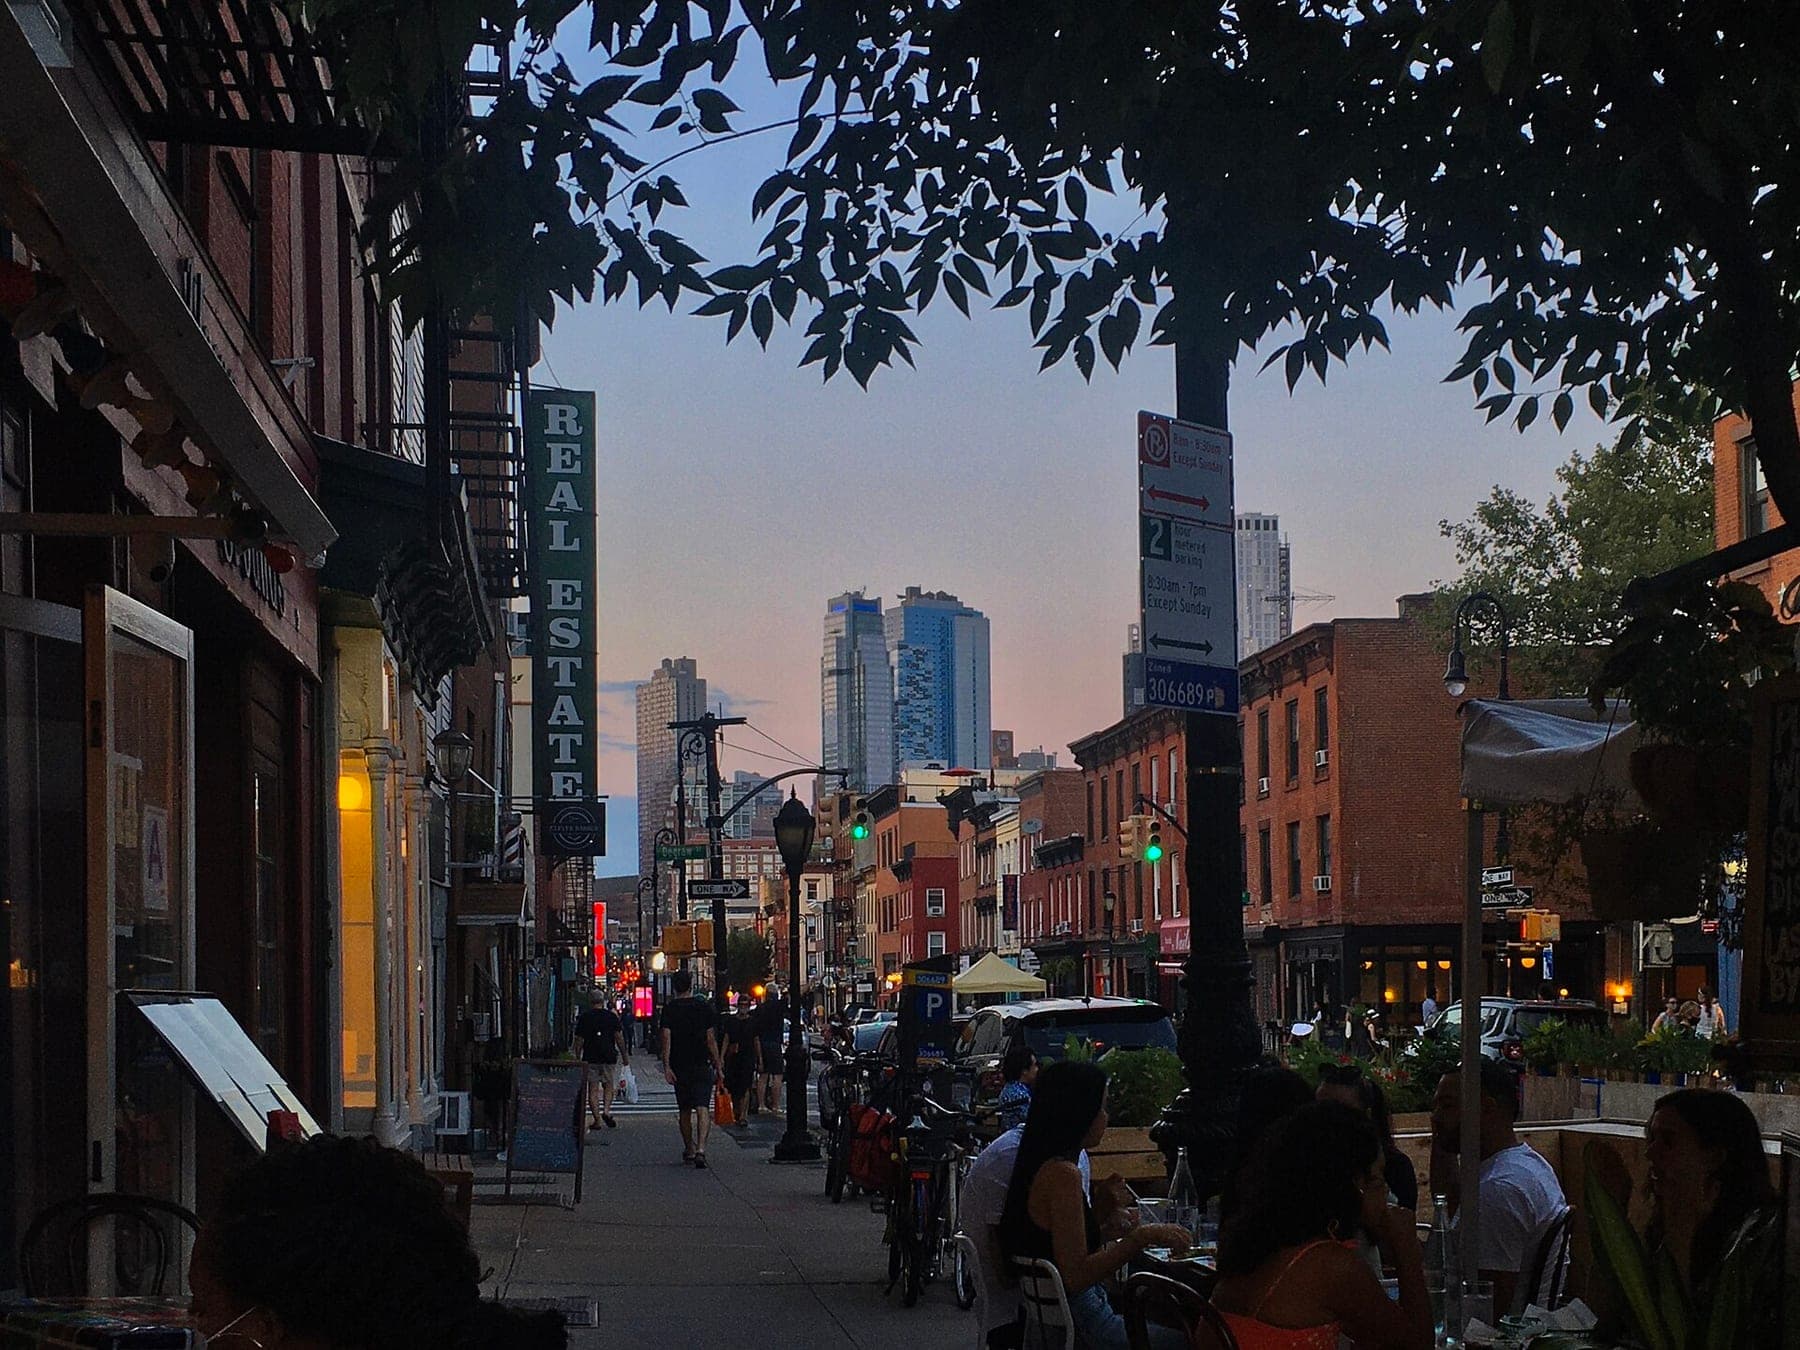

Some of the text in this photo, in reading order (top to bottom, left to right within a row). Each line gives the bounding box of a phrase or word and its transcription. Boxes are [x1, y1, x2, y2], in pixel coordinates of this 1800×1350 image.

[543, 404, 584, 551] REAL
[1149, 518, 1164, 556] 2
[1147, 574, 1180, 593] 8:30am
[1188, 580, 1207, 599] 7pm
[1147, 592, 1211, 618] Except Sunday
[546, 579, 585, 802] ESTATE
[1149, 677, 1204, 705] 306689
[148, 820, 164, 881] A
[697, 885, 741, 893] ONE WAY
[927, 993, 943, 1017] P
